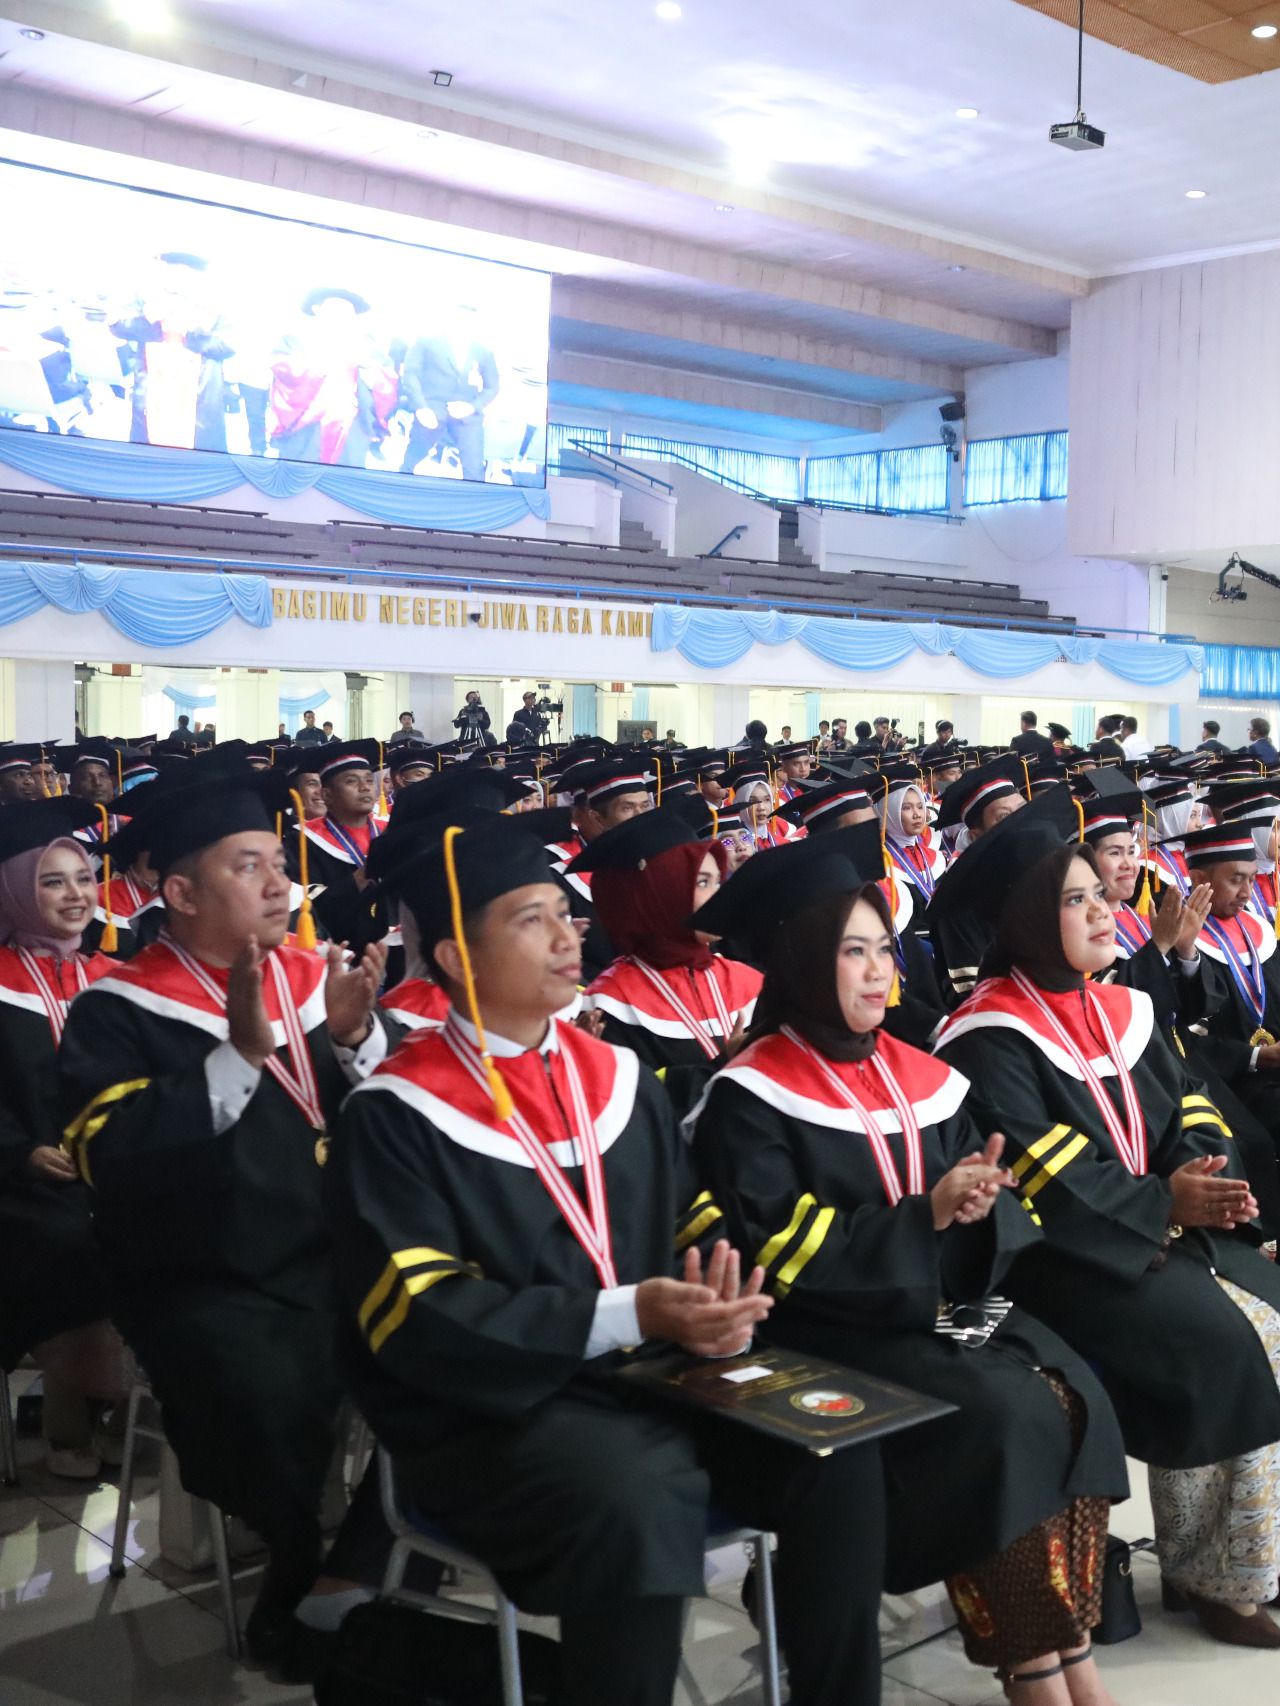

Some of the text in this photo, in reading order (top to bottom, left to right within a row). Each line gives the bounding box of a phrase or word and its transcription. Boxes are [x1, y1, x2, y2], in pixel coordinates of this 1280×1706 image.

[272, 588, 653, 638] BAGIMU NEGERI JIWA RAGA KAMI
